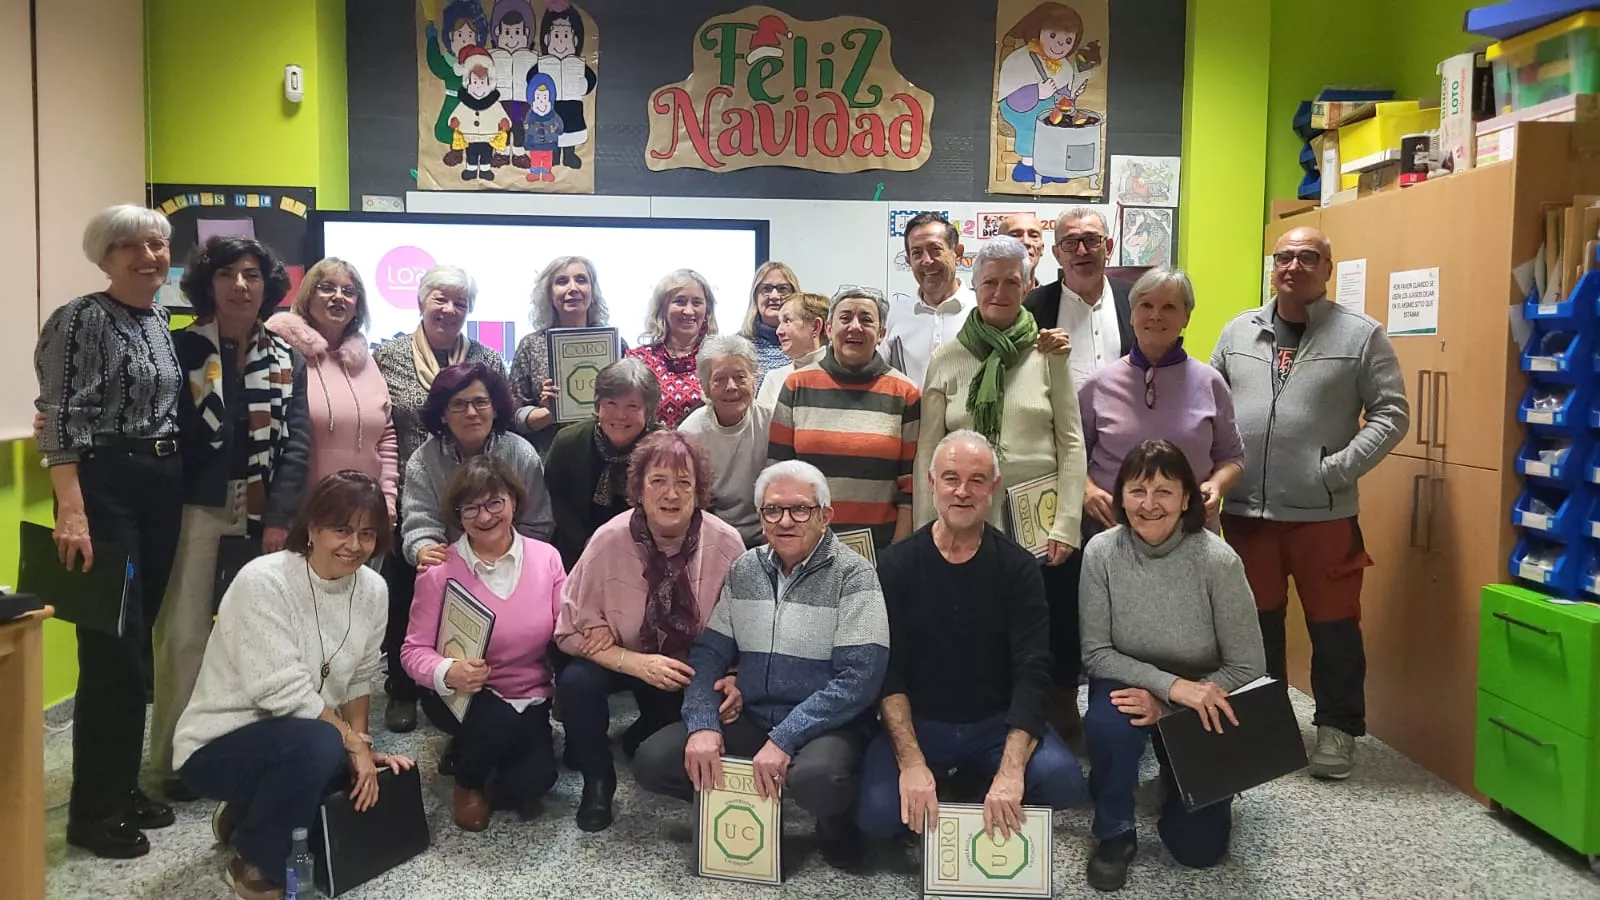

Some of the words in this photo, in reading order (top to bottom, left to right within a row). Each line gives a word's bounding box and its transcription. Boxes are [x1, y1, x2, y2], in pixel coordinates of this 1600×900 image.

[1451, 80, 1460, 115] LOTO
[650, 86, 924, 168] Navidad
[564, 343, 605, 356] CORO
[940, 820, 957, 878] CORO
